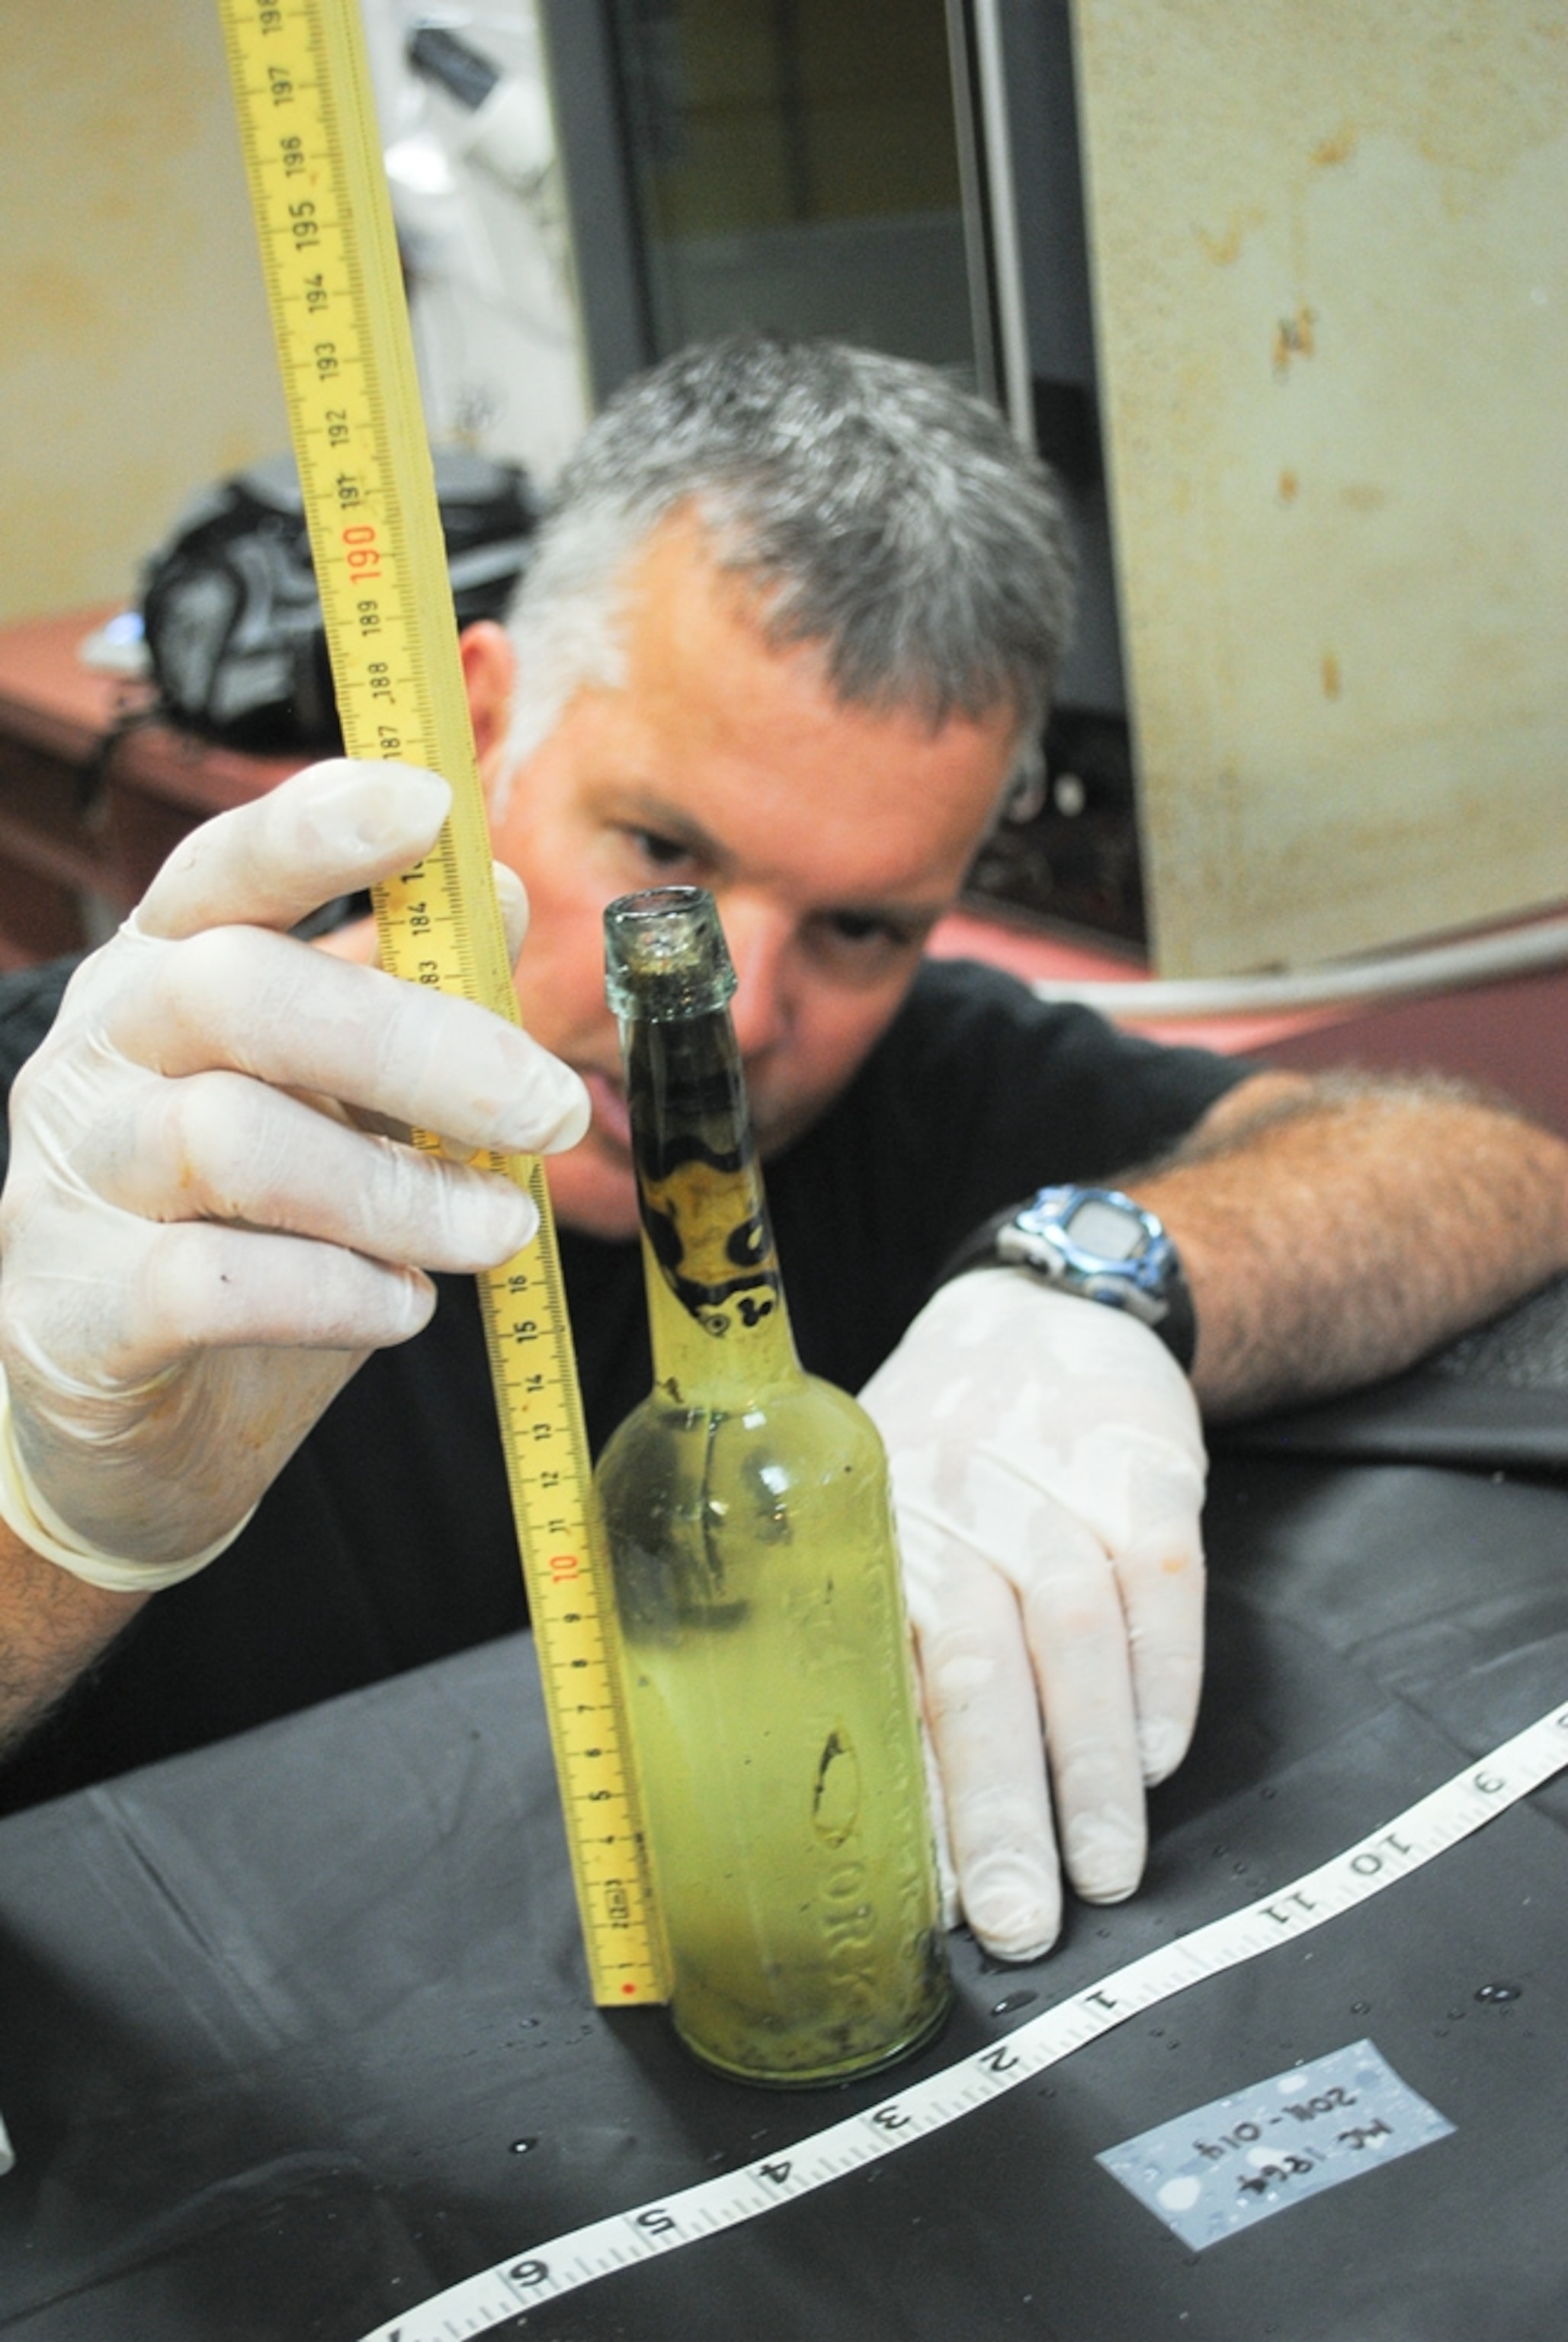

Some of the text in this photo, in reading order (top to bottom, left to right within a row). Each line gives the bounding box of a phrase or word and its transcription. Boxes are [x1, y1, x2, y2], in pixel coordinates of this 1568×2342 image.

[268, 66, 293, 107] 197
[281, 136, 306, 178] 196
[289, 201, 320, 252] 195
[305, 274, 328, 313] 194
[314, 342, 340, 380] 193
[326, 409, 350, 448] 192
[337, 473, 361, 510] 191
[342, 525, 381, 585] 190
[358, 600, 381, 637] 189
[368, 662, 391, 699] 188
[378, 725, 401, 759] 187
[409, 902, 431, 936] 184
[419, 961, 441, 990] 83
[508, 1275, 529, 1294] 16
[514, 1320, 537, 1344] 15
[526, 1375, 544, 1393] 14
[532, 1423, 551, 1440] 13
[541, 1472, 558, 1488] 12
[548, 1519, 564, 1533] 11
[550, 1556, 578, 1584] 10
[563, 1613, 581, 1623] 9
[577, 1705, 595, 1714] 7
[589, 1790, 611, 1801] 5
[1350, 1833, 1412, 1877] 10
[1258, 1891, 1316, 1924] 11
[1085, 1991, 1117, 2010] 1
[981, 2045, 1020, 2072] 2
[873, 2106, 912, 2130] 3
[760, 2161, 793, 2184] 4
[636, 2209, 676, 2235] 5
[511, 2260, 549, 2286] 6
